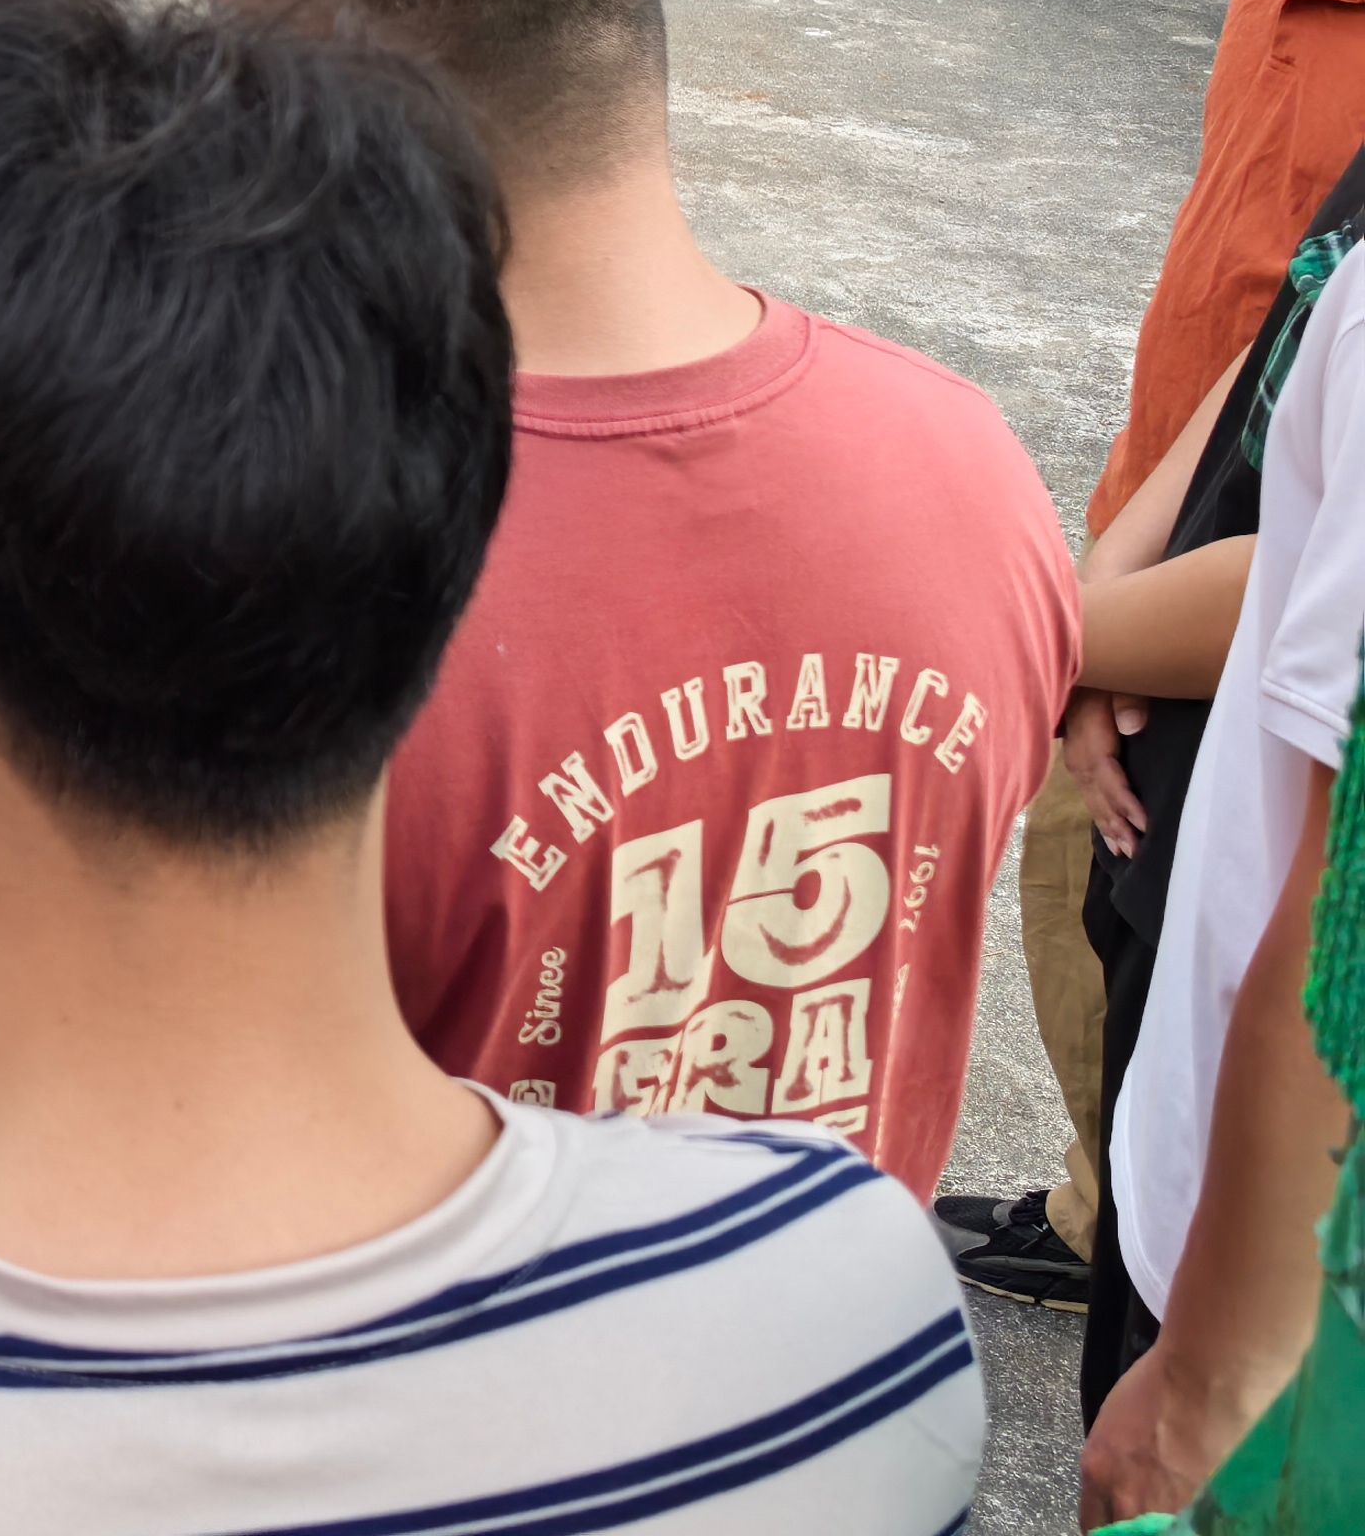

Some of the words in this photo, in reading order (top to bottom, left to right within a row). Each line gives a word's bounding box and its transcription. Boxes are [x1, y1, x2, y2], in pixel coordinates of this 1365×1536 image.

[489, 652, 988, 892] ENDURANCE
[600, 773, 892, 1047] 15
[898, 843, 942, 934] 1997
[518, 946, 567, 1047] Since
